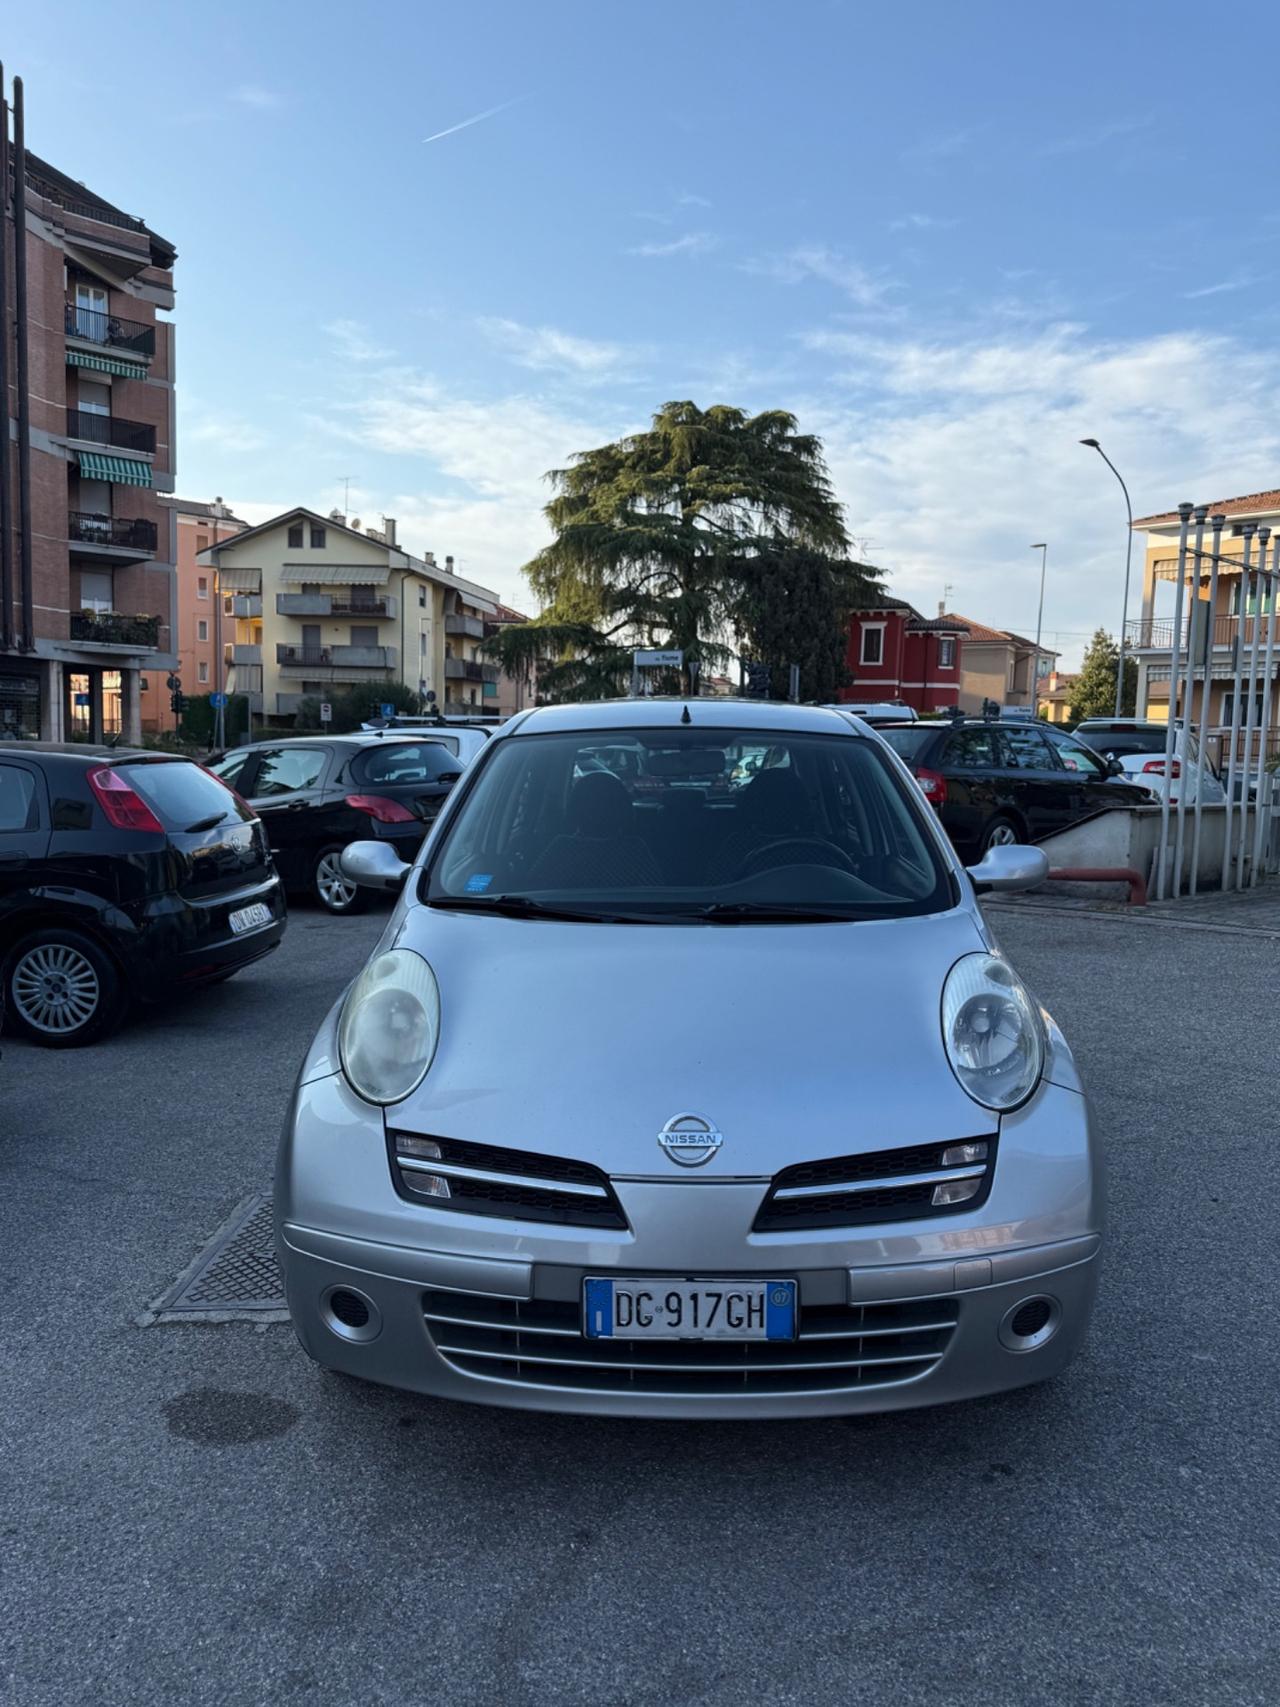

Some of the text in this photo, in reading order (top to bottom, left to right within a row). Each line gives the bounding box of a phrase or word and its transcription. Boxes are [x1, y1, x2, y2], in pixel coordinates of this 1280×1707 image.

[664, 1134, 716, 1144] NISSAN
[773, 1290, 787, 1303] 07
[664, 1291, 765, 1329] 917GH
